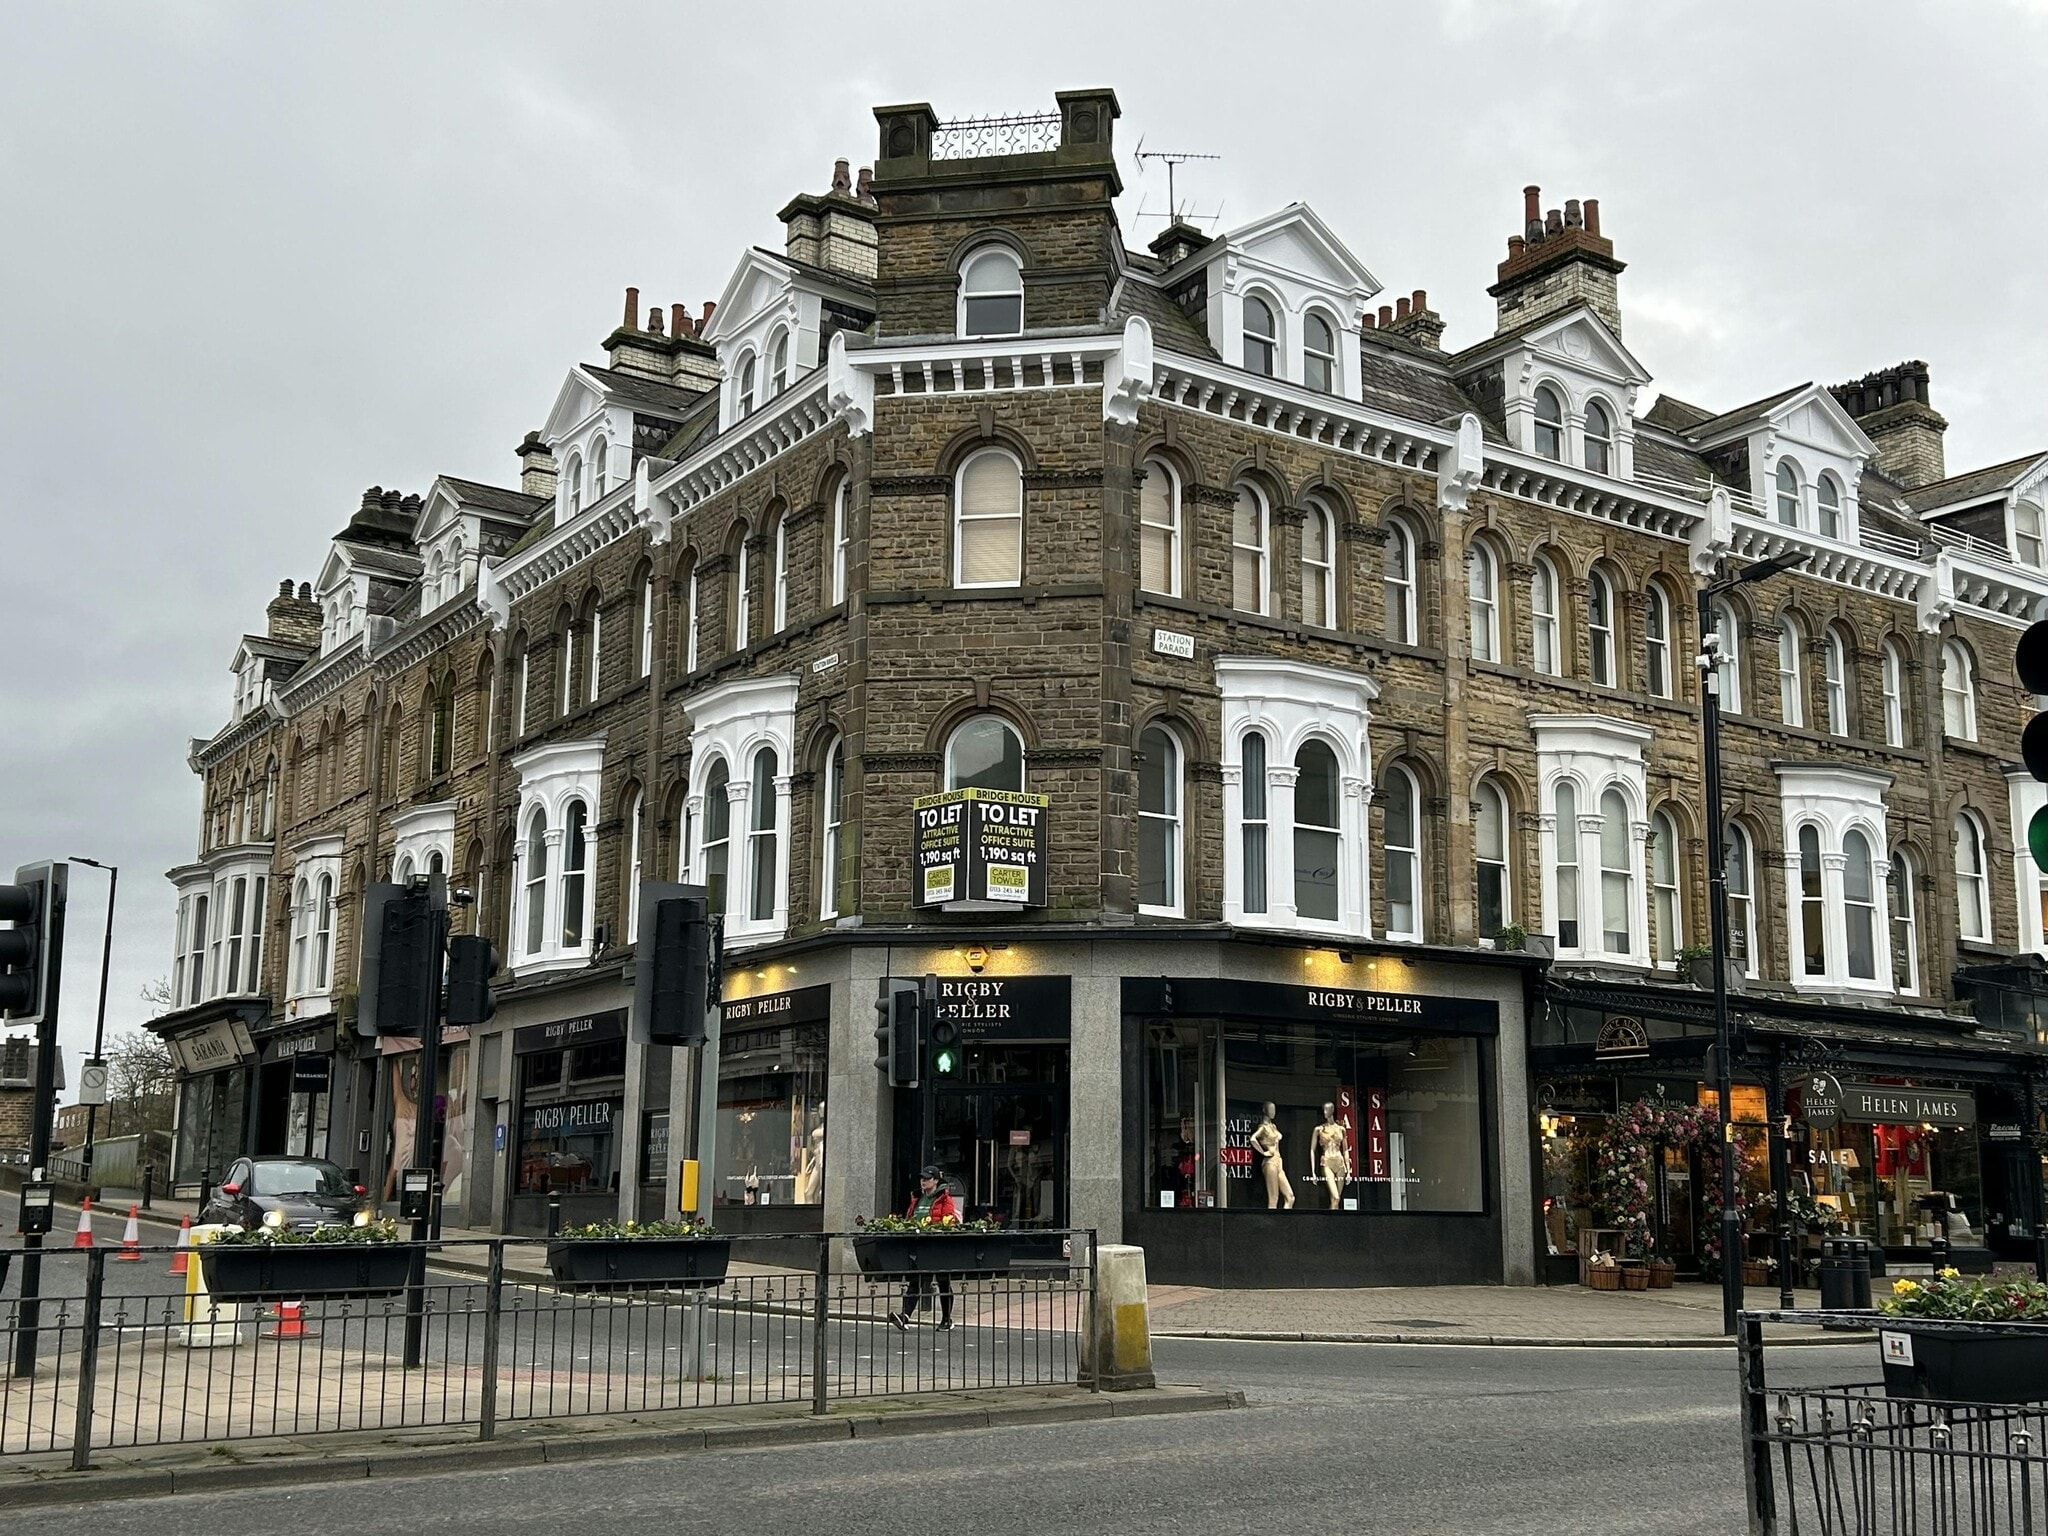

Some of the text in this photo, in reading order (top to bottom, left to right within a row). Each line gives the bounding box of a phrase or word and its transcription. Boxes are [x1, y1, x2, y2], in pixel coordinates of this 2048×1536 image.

[1158, 632, 1191, 646] STATION
[1159, 642, 1190, 655] PARADE
[918, 790, 964, 807] BRIDGE HOUSE
[976, 790, 1041, 805] BRIDGE HOUSE
[920, 804, 963, 828] TO LET
[978, 803, 1039, 826] TO LET
[922, 825, 959, 839] ATTRACTIVE
[983, 824, 1034, 837] ATTRACTIVE
[921, 836, 960, 850] OFFICE SUITE
[981, 835, 1036, 848] OFFICE SUITE
[920, 847, 960, 866] 1,190 sq ft
[980, 846, 1037, 864] 1,190 sq ft
[928, 870, 949, 880] CARTER
[992, 868, 1021, 878] CARTER
[992, 876, 1024, 886] TOWLER
[942, 982, 1004, 997] RIGBY
[726, 1003, 752, 1020] RIGBY
[757, 996, 791, 1015] PELLER
[1308, 991, 1354, 1008] RIGBY
[1367, 996, 1422, 1014] PELLER
[936, 1004, 1011, 1018] PELLER
[545, 1019, 593, 1038] RIGBY PELLER
[191, 1040, 228, 1061] SARANDA
[1806, 1098, 1836, 1106] HELEN
[1862, 1096, 1958, 1118] HELEN JAMES
[534, 1102, 610, 1129] RIGBY PELLER
[1807, 1108, 1835, 1117] JAMES
[1371, 1093, 1383, 1175] SALE
[1220, 1149, 1252, 1163] SALE
[1809, 1150, 1849, 1165] SALE
